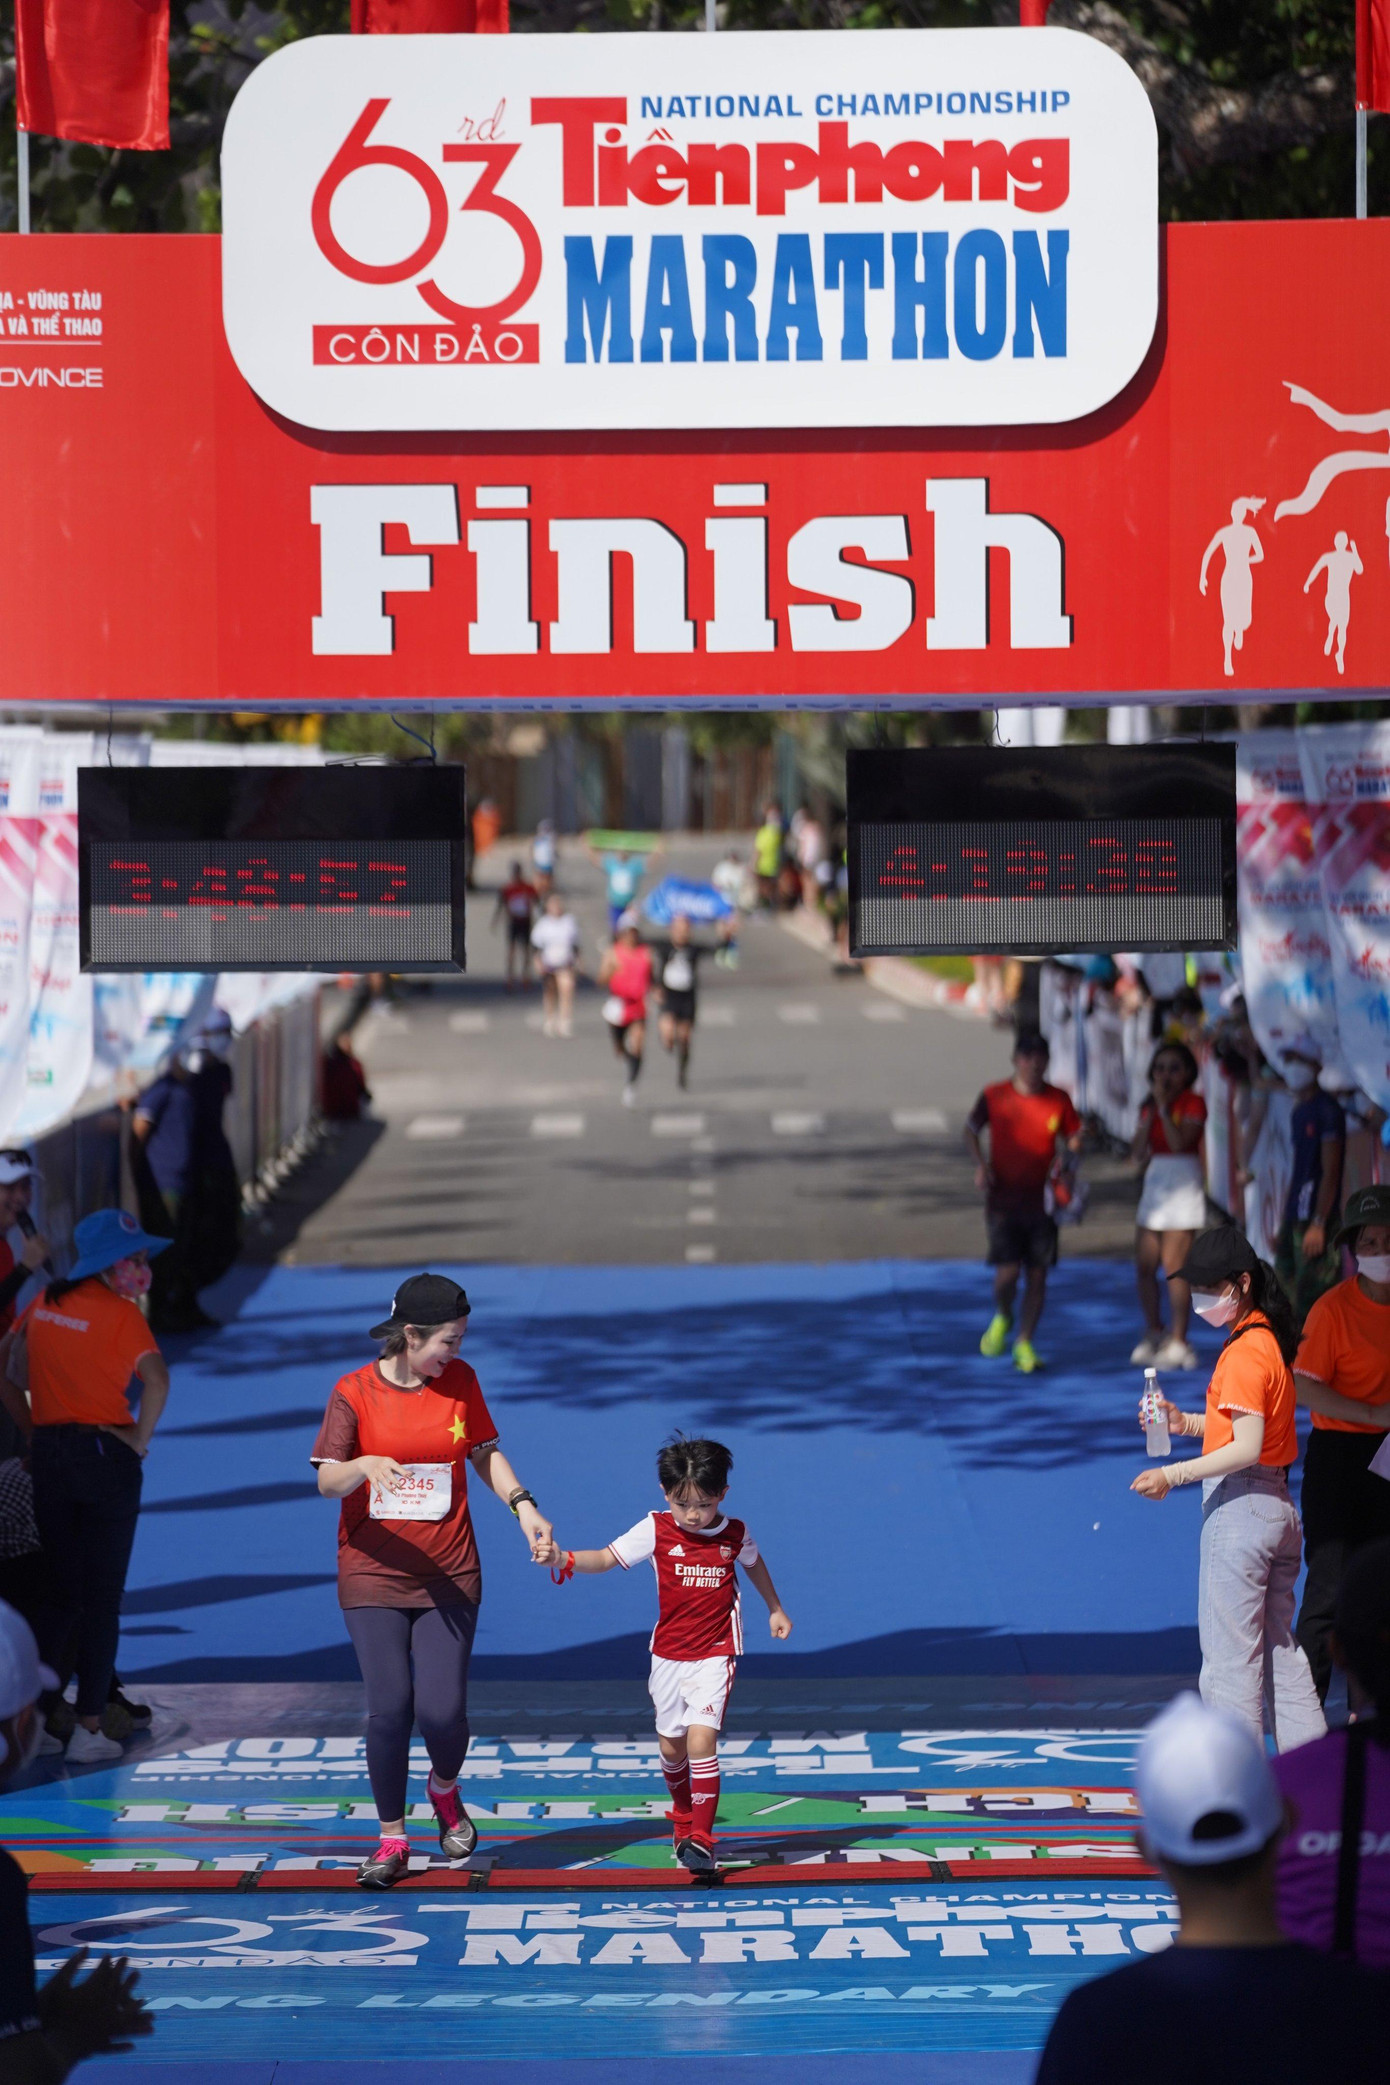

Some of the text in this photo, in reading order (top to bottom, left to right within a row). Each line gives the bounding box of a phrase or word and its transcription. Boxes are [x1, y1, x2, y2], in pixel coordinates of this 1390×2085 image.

[641, 90, 1071, 118] NATIONAL CHAMPIONSHIP
[27, 288, 70, 310] VŨNG
[72, 289, 102, 311] TÀU
[564, 228, 1070, 364] MARATHON
[8, 313, 29, 335] VÀ
[63, 317, 103, 336] THAO
[329, 324, 524, 363] CÔN ĐẢO
[310, 477, 1075, 656] Finish
[674, 1563, 727, 1578] Emirates
[682, 1576, 720, 1588] FLY BETTER
[601, 1897, 870, 1910] NATIONAL
[458, 1923, 1181, 1966] MARATHO
[356, 1983, 1055, 2008] LEGENDARY
